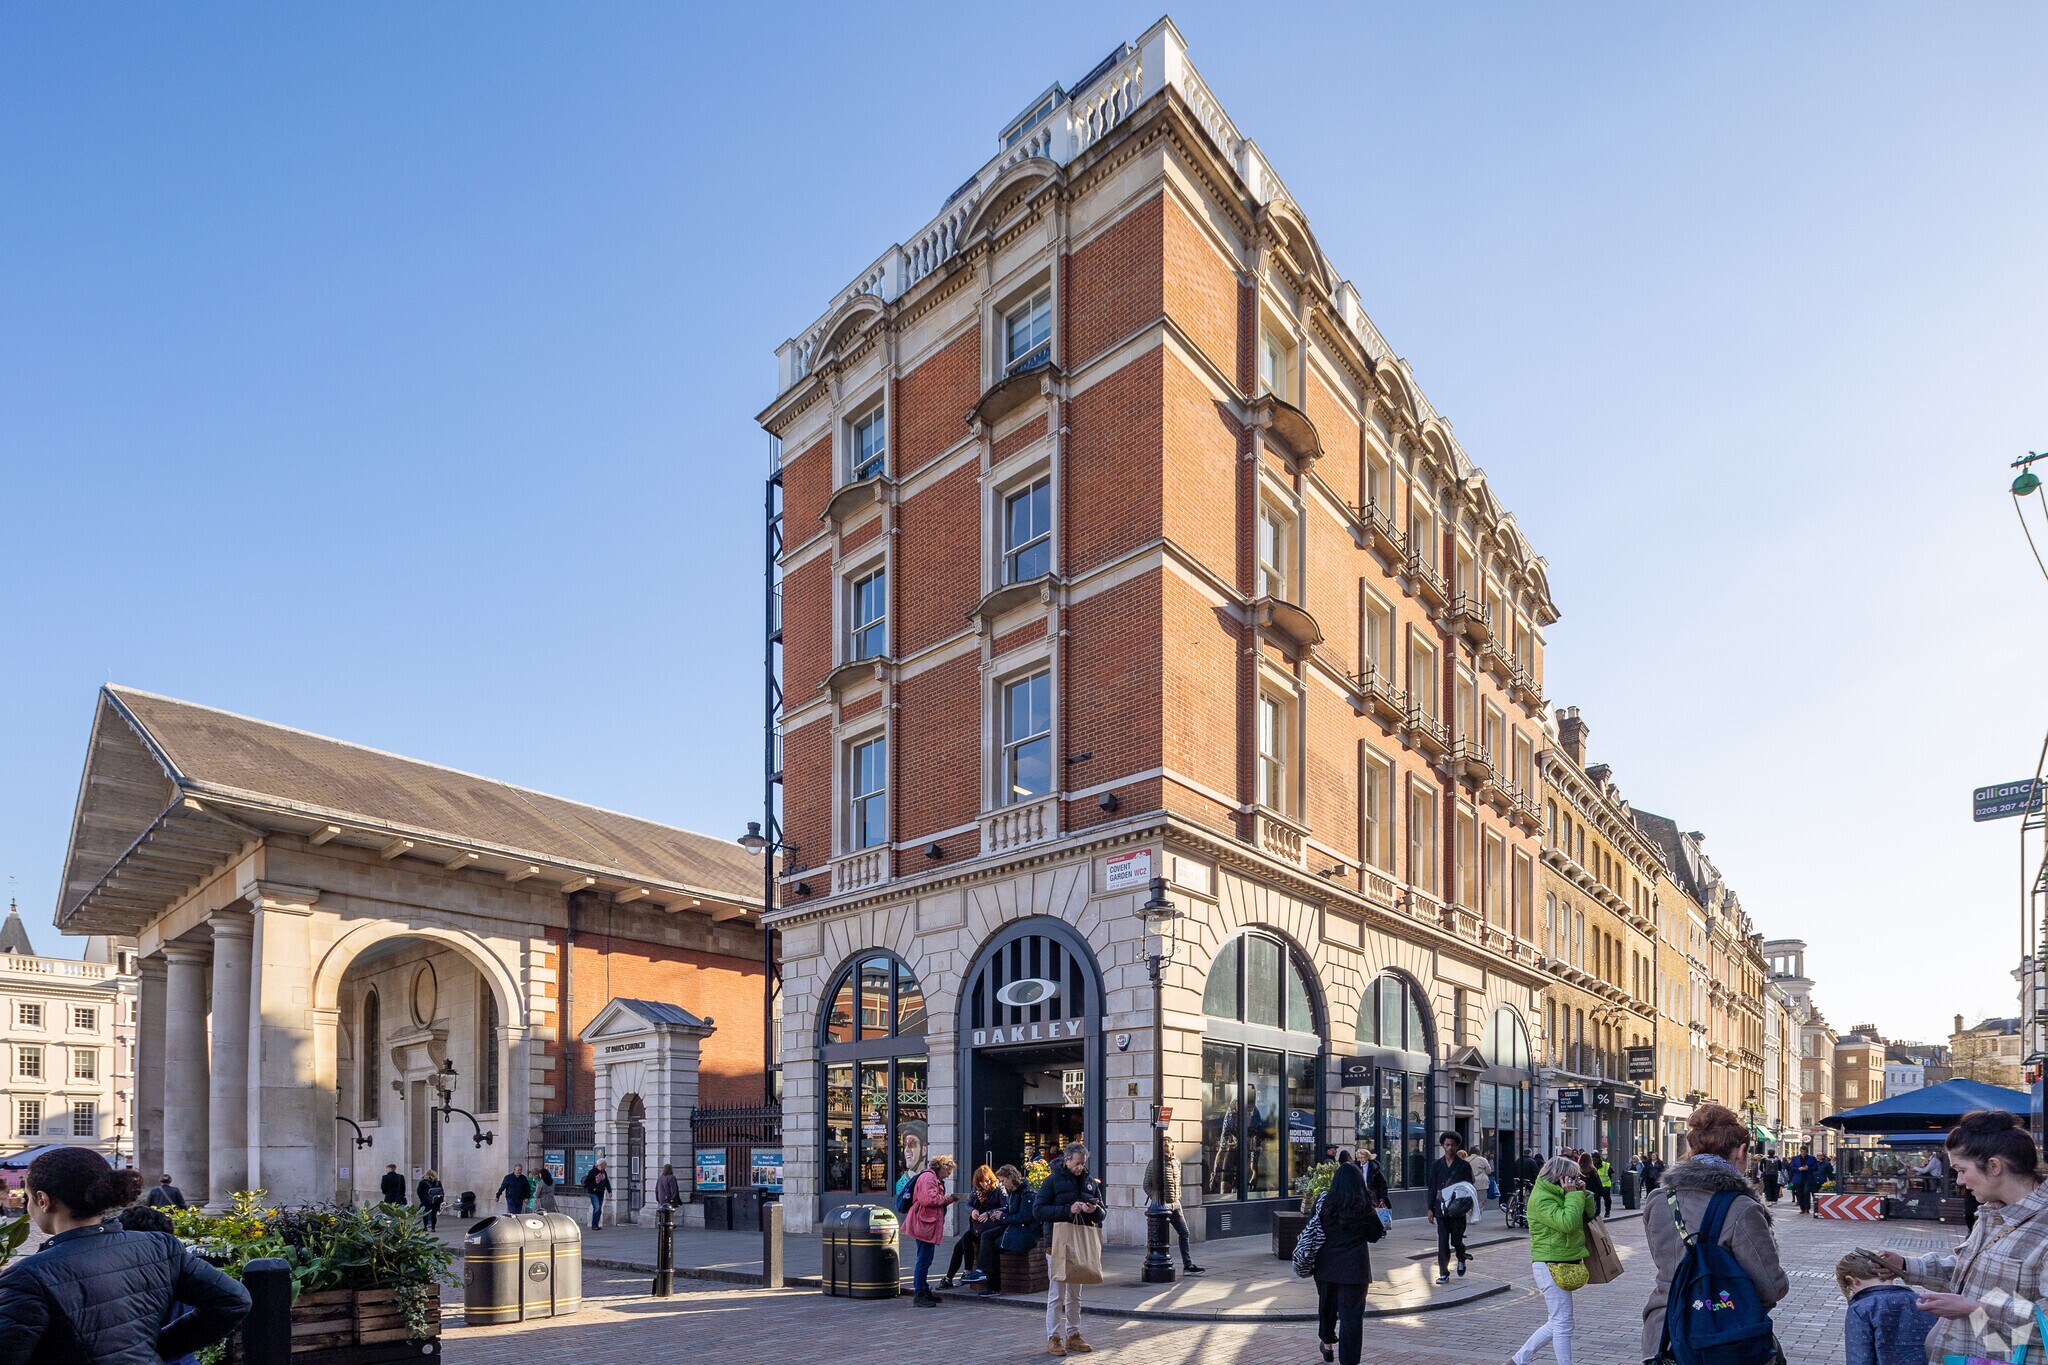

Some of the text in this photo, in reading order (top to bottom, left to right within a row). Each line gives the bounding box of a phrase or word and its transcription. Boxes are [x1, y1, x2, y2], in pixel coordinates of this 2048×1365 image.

[1976, 807, 1998, 815] 0208
[2000, 803, 2016, 811] 207
[1110, 863, 1131, 873] COVENT
[1110, 868, 1147, 881] GARDEN WC2
[973, 1020, 1080, 1046] OAKLEY
[625, 1042, 645, 1051] CHURCH
